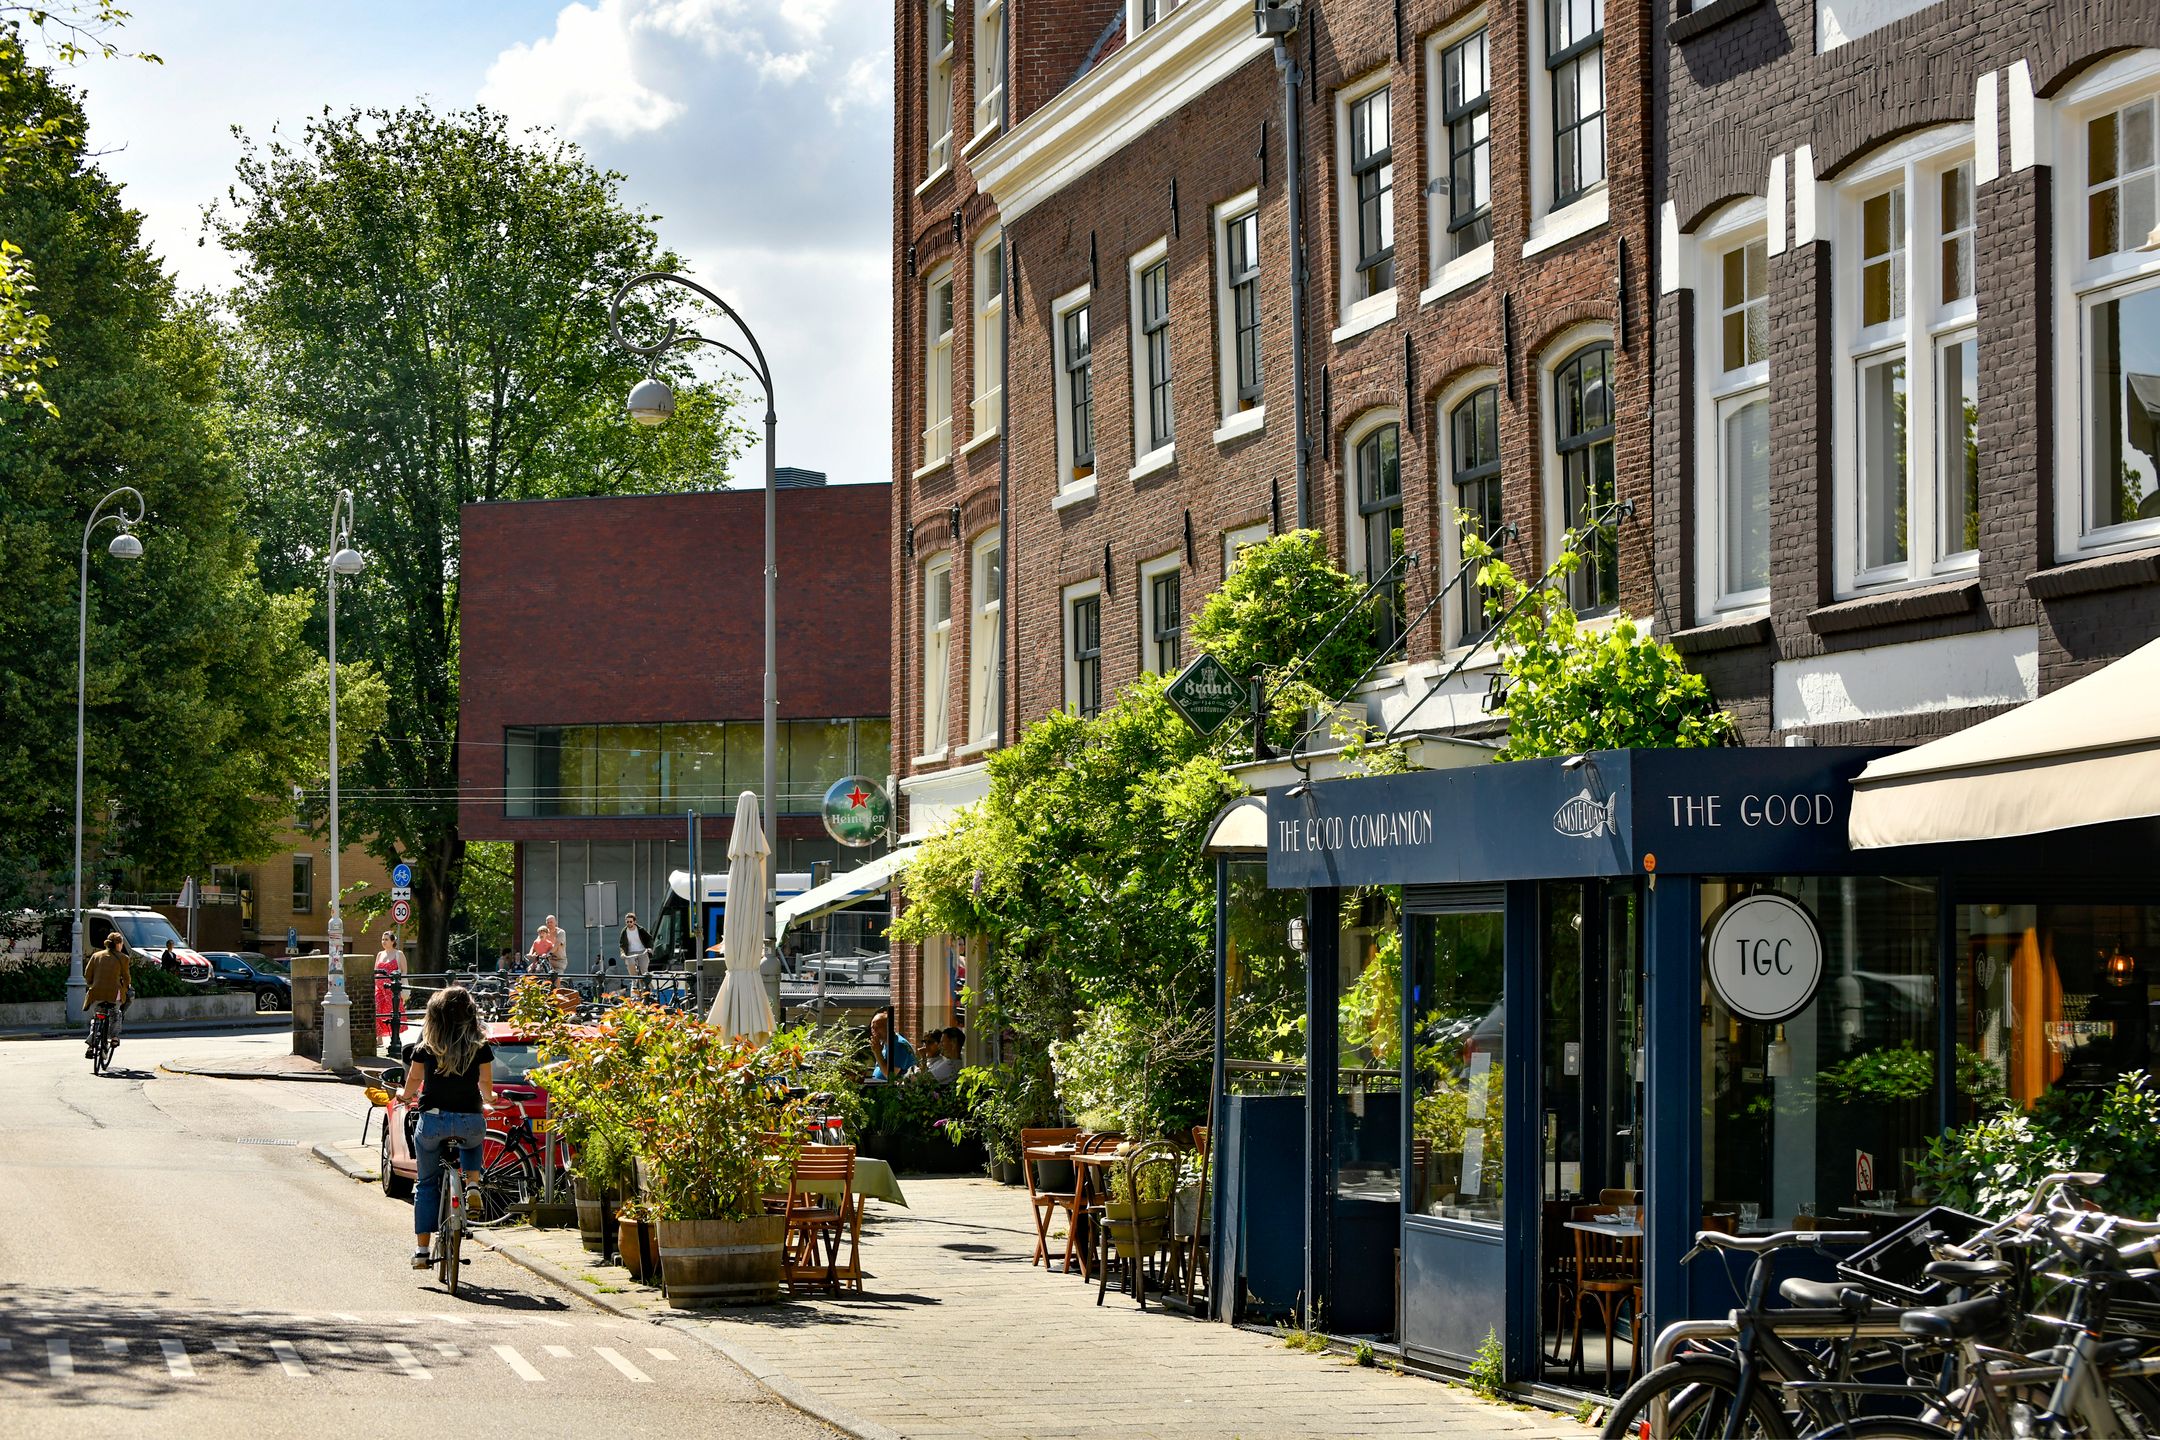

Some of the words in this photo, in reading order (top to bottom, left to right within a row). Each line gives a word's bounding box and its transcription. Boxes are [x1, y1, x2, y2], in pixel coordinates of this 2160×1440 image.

[1184, 679, 1233, 696] Brand
[1557, 801, 1606, 832] AMSTERDAM
[1667, 795, 1722, 827] THE
[1740, 794, 1834, 827] GOOD
[1278, 820, 1301, 852] THE
[1306, 816, 1344, 852] GOOD
[1350, 809, 1432, 849] COMPANION
[395, 907, 407, 917] 30
[1736, 938, 1793, 976] TGC
